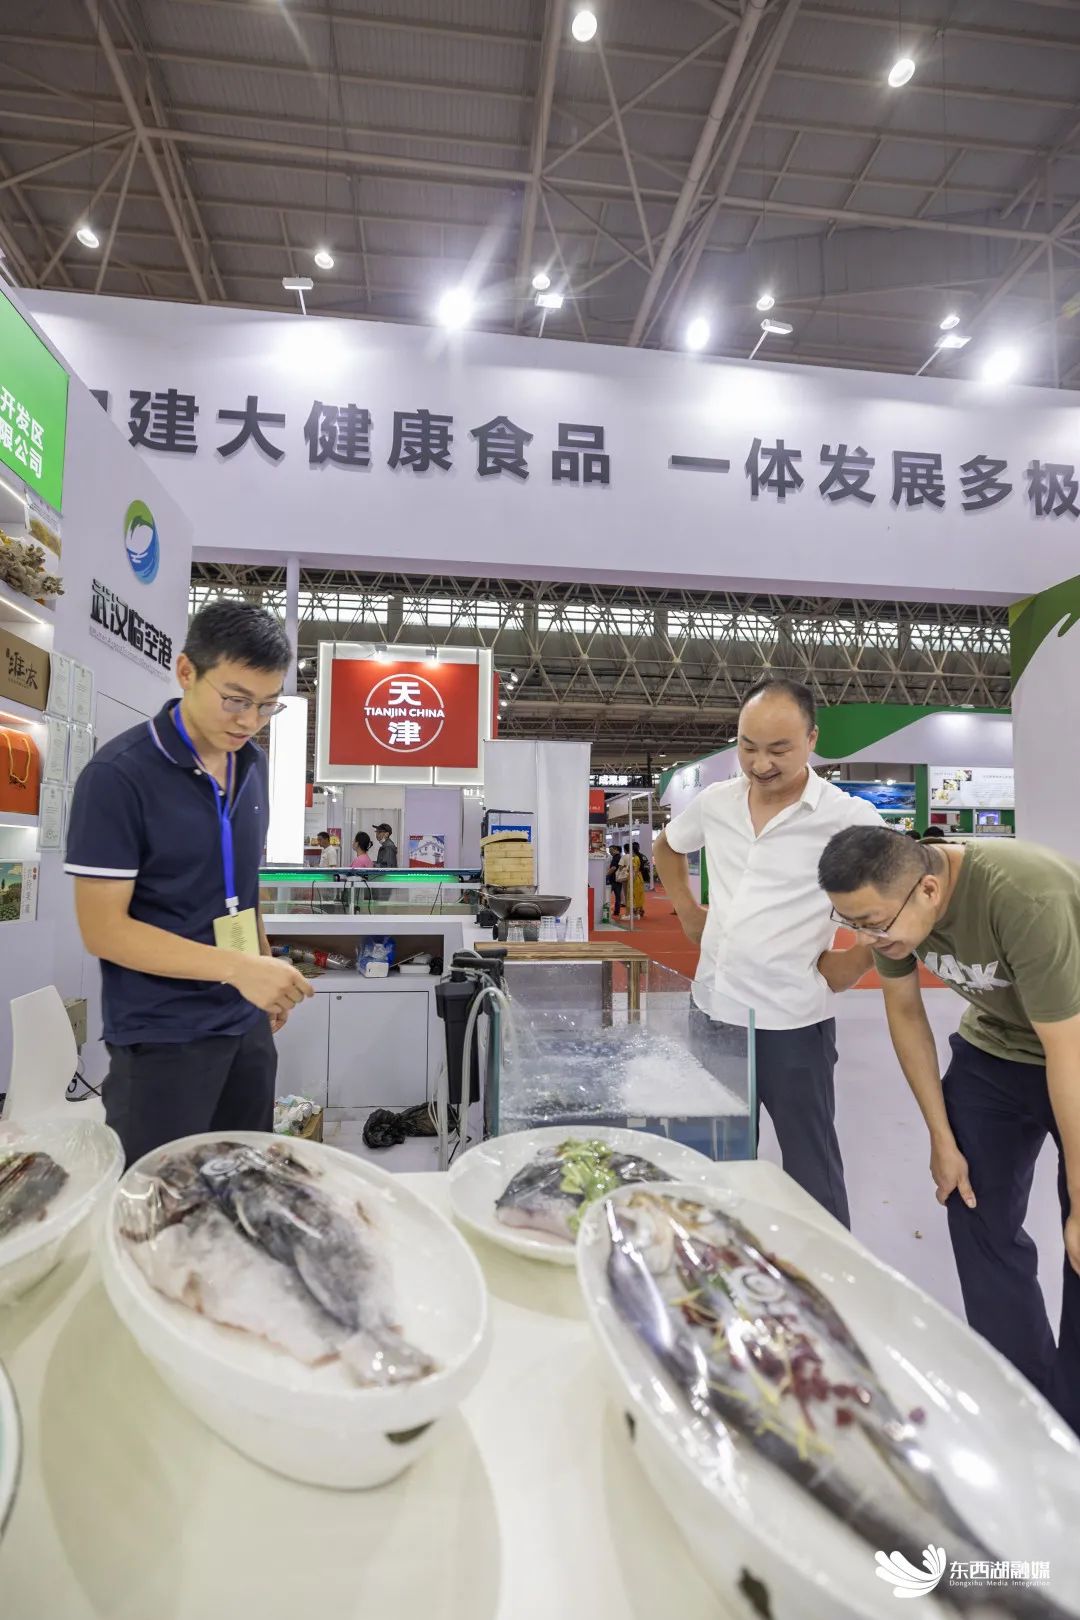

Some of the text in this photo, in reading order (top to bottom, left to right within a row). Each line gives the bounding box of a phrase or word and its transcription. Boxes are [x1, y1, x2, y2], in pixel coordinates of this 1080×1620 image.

[0, 385, 44, 452] 开发区
[89, 388, 1080, 517] 建大健康食品 一体发展多极
[90, 579, 172, 671] 武汉临空港
[364, 707, 445, 718] TIANJIN CHINA
[388, 681, 422, 706] 天
[388, 720, 421, 745] 津
